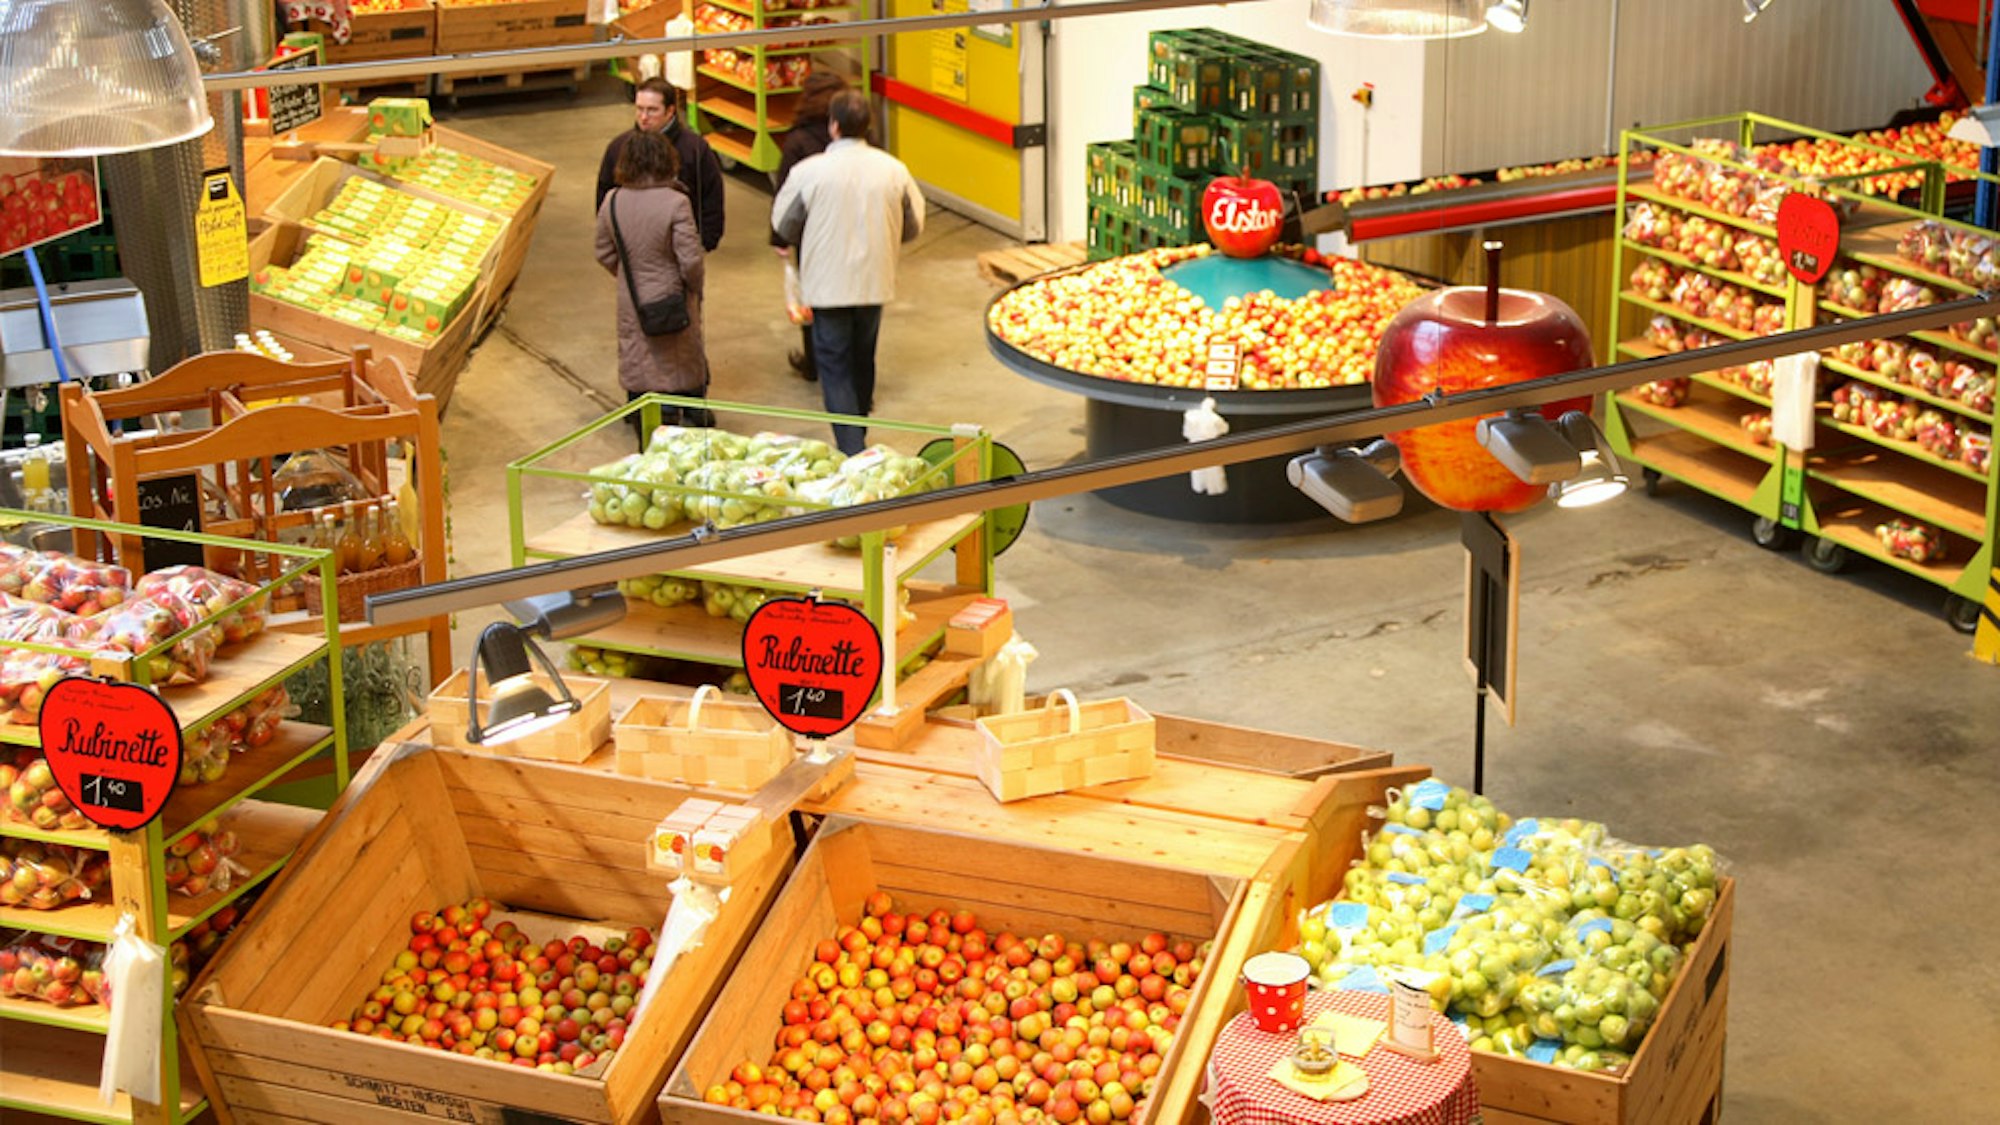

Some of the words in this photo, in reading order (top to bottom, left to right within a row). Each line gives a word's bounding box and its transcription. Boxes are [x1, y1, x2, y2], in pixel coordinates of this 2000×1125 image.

[1211, 197, 1283, 233] Elstar
[757, 634, 864, 677] Rubinette
[787, 687, 826, 715] 1,40
[58, 717, 169, 767] Rubinette
[84, 775, 126, 807] 1,40
